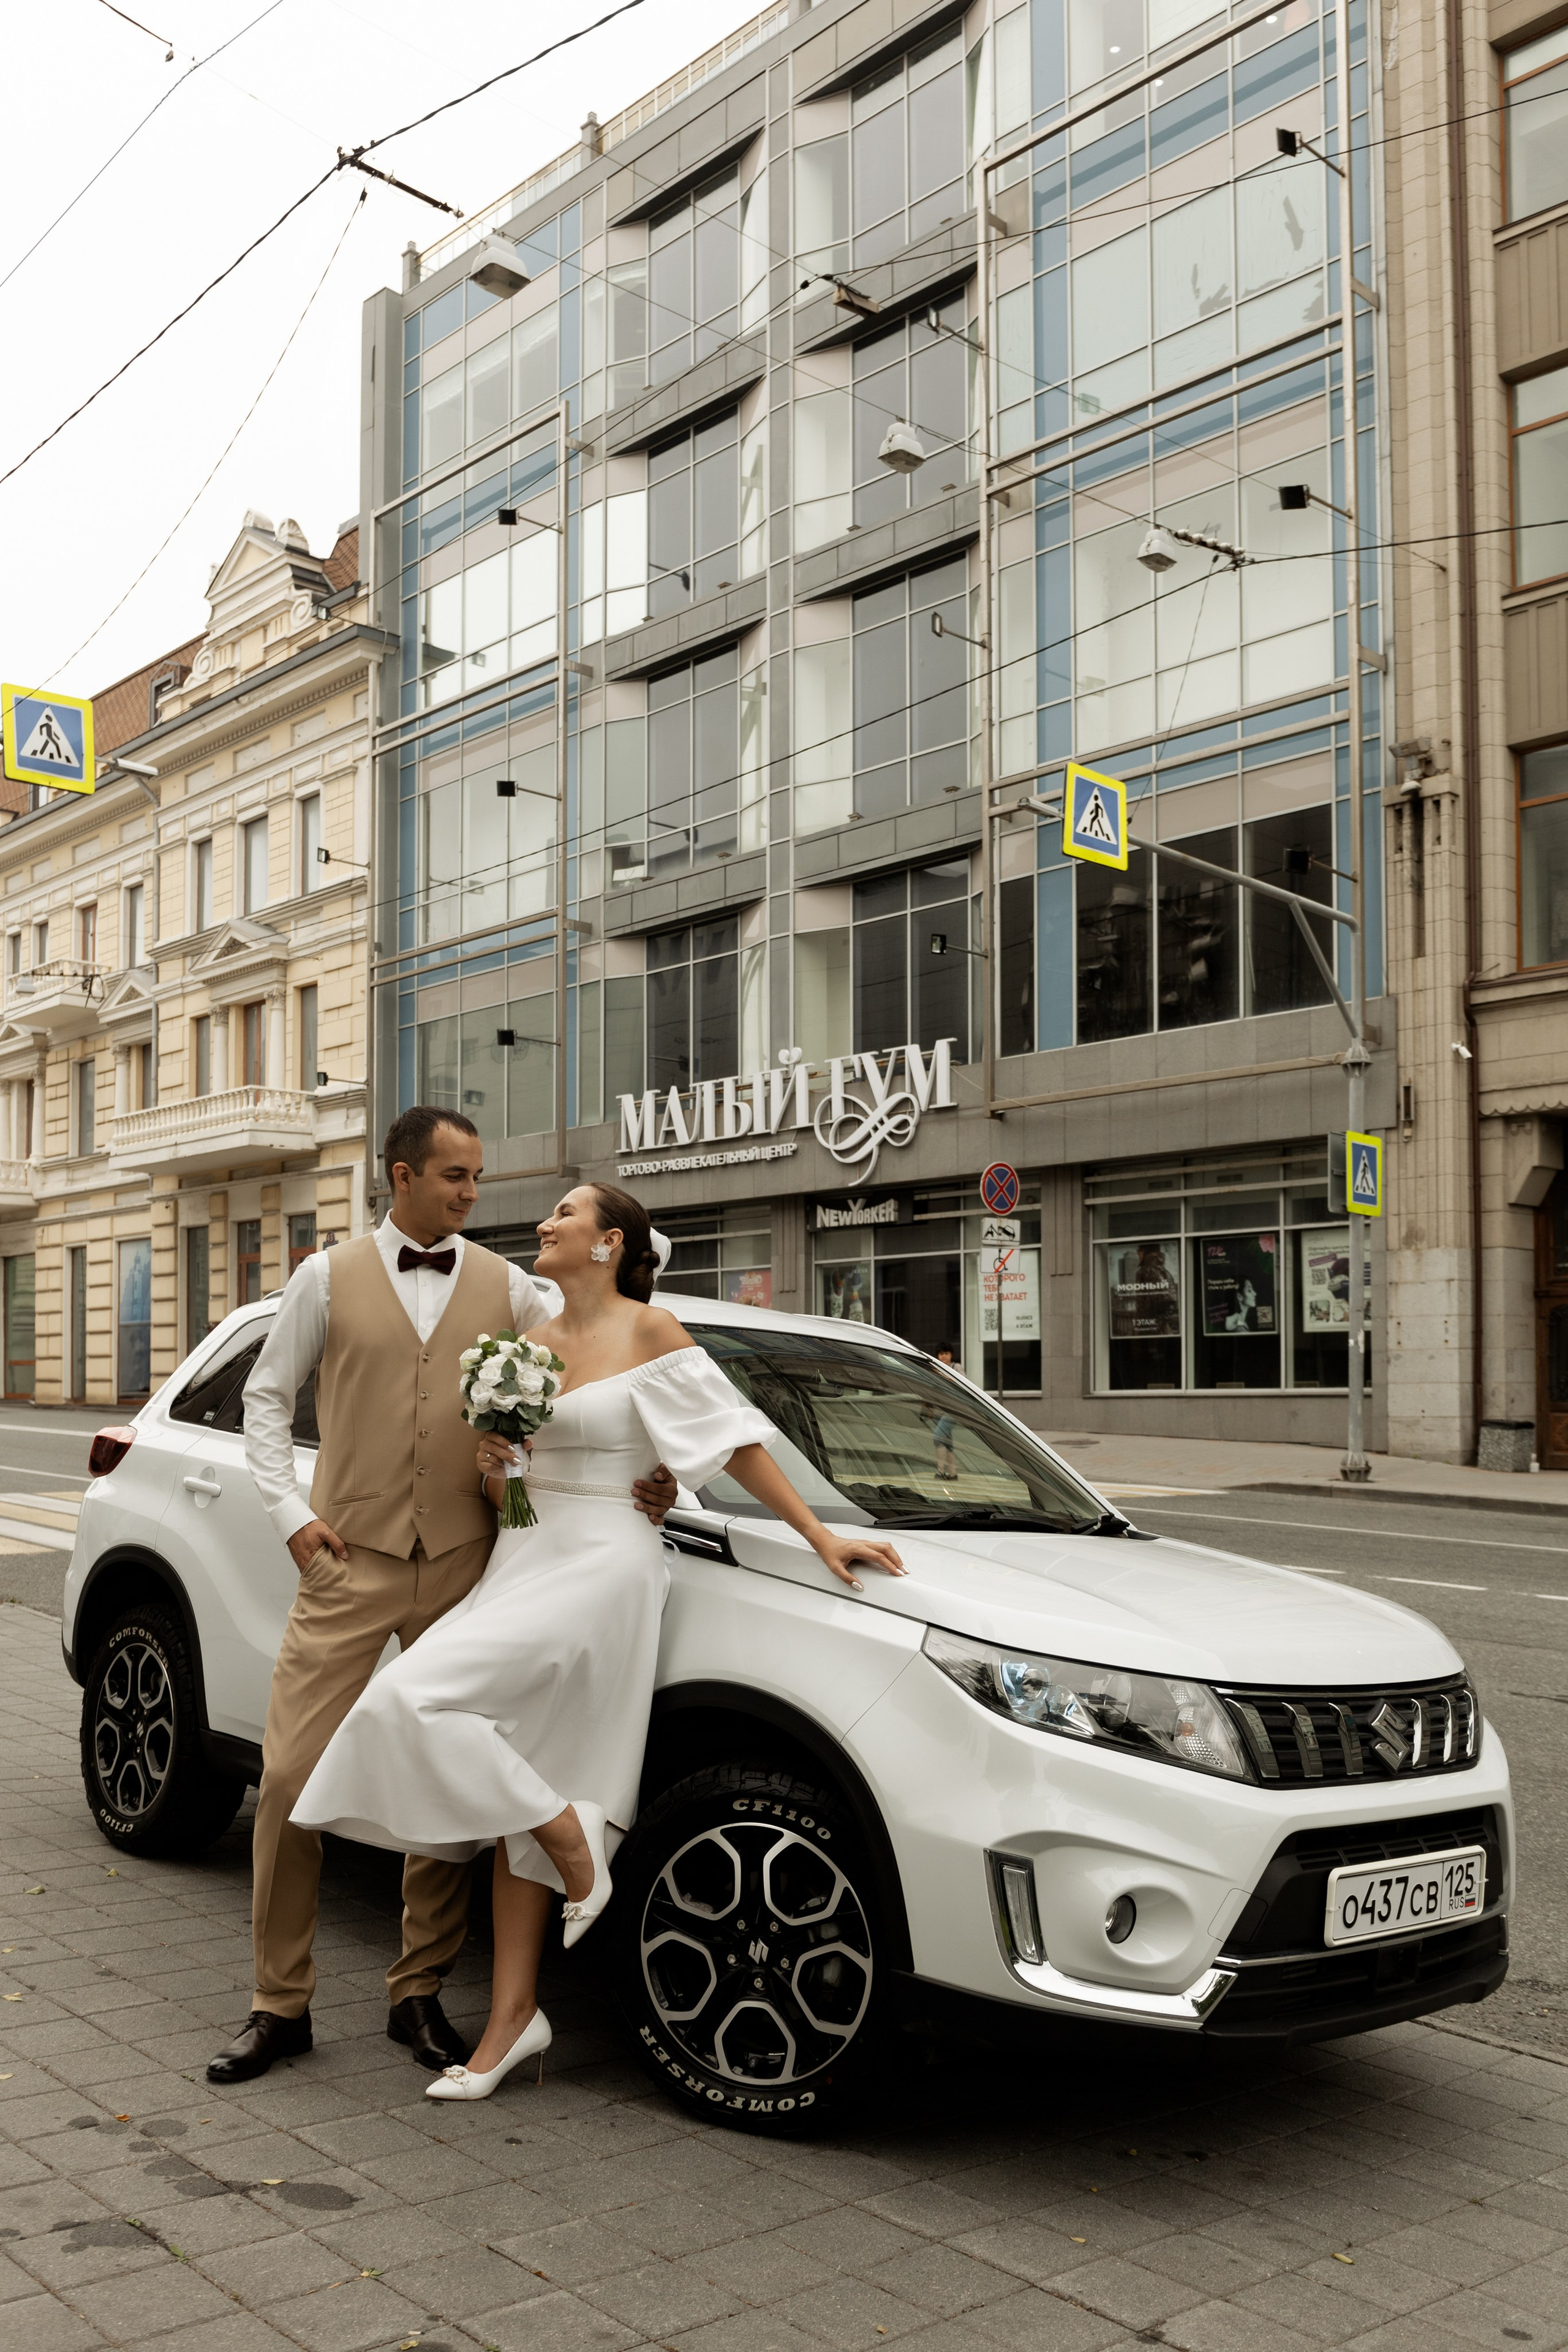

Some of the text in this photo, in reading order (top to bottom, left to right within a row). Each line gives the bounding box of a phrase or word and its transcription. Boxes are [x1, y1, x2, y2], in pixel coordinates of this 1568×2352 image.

[615, 1038, 958, 1186] МАЛЫЙ ГУМ
[617, 1143, 797, 1177] ТОРГОВО-РАЗВЛЕКАТЕЛЬНЫЙ ЦЕНТР
[109, 1627, 169, 1670] COMFORSER
[100, 1809, 134, 1832] CF1100
[733, 1799, 831, 1840] CF1100
[1445, 1861, 1474, 1898] 125
[1449, 1896, 1464, 1910] RUS
[639, 2025, 816, 2113] COMFORSER
